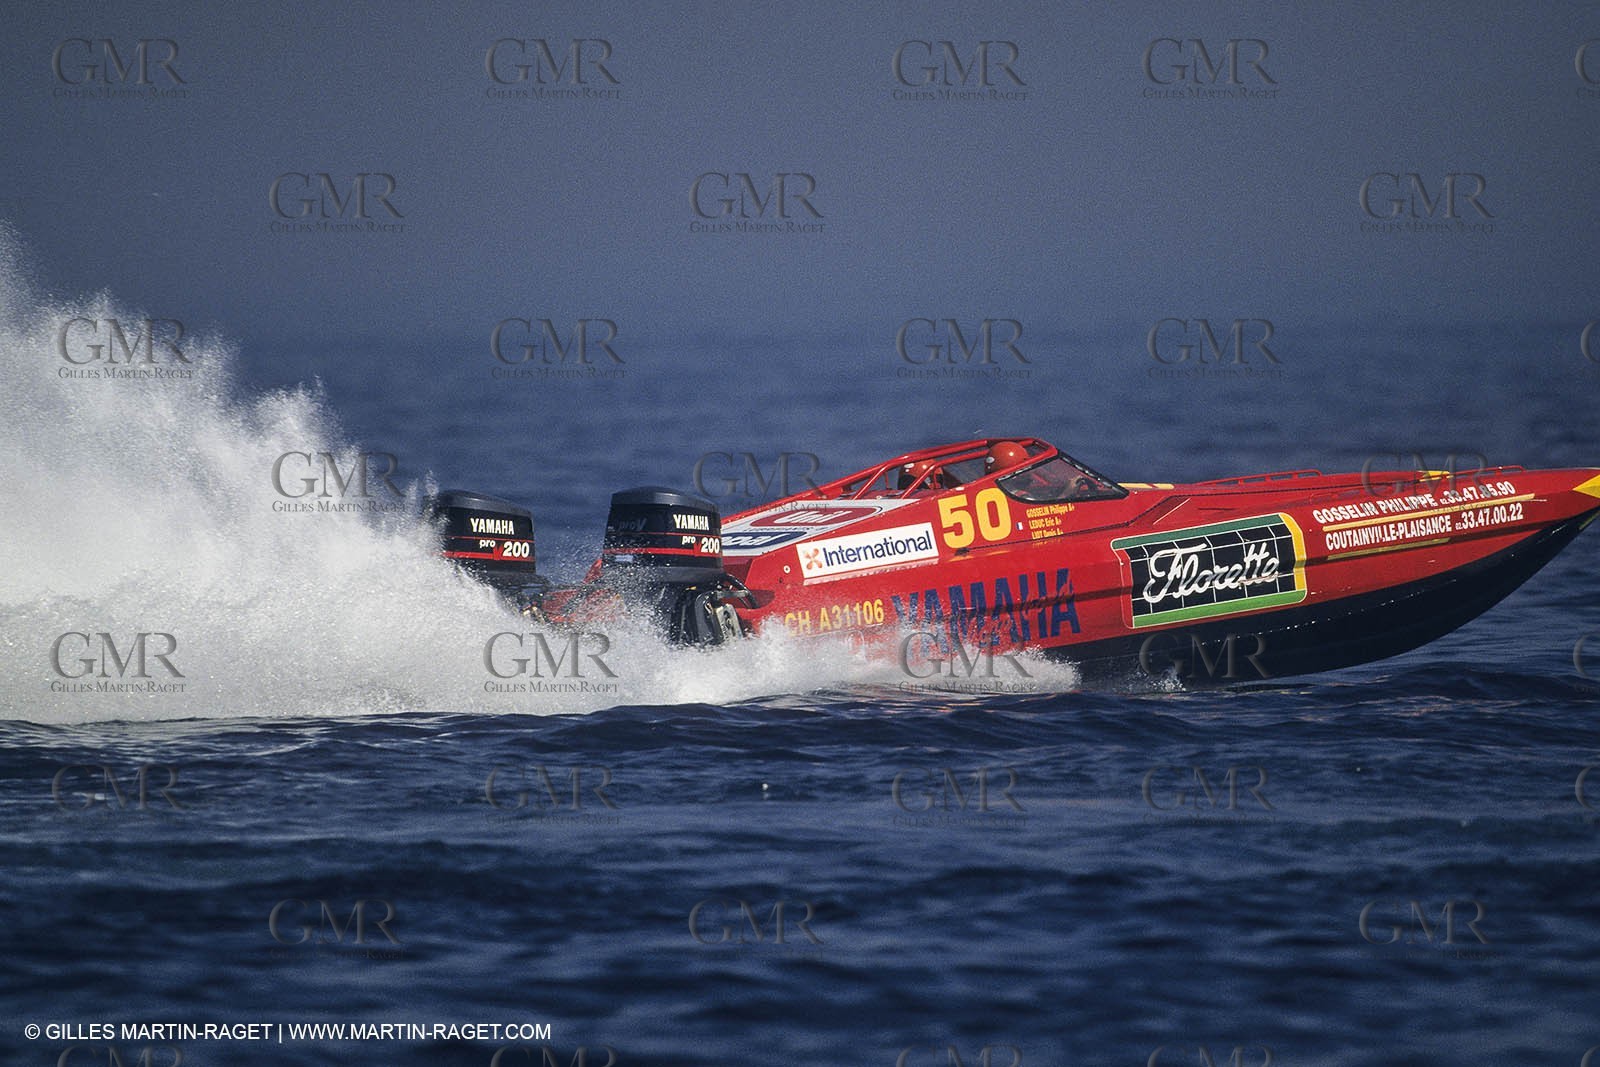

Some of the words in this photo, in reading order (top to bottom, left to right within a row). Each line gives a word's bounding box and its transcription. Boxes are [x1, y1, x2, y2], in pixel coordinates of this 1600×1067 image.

[673, 514, 710, 530] YAMAHA
[938, 487, 1012, 549] 50
[1312, 500, 1379, 525] GOSSELIN
[1377, 493, 1439, 515] PHILIPPE
[470, 518, 514, 535] YAMAHA
[480, 540, 496, 548] pro
[503, 541, 530, 558] 200
[682, 536, 697, 545] pro
[701, 537, 720, 553] 200
[823, 531, 932, 566] International
[1143, 541, 1280, 603] Florette
[820, 599, 884, 631] A31106
[890, 568, 1081, 655] YAMAHA
